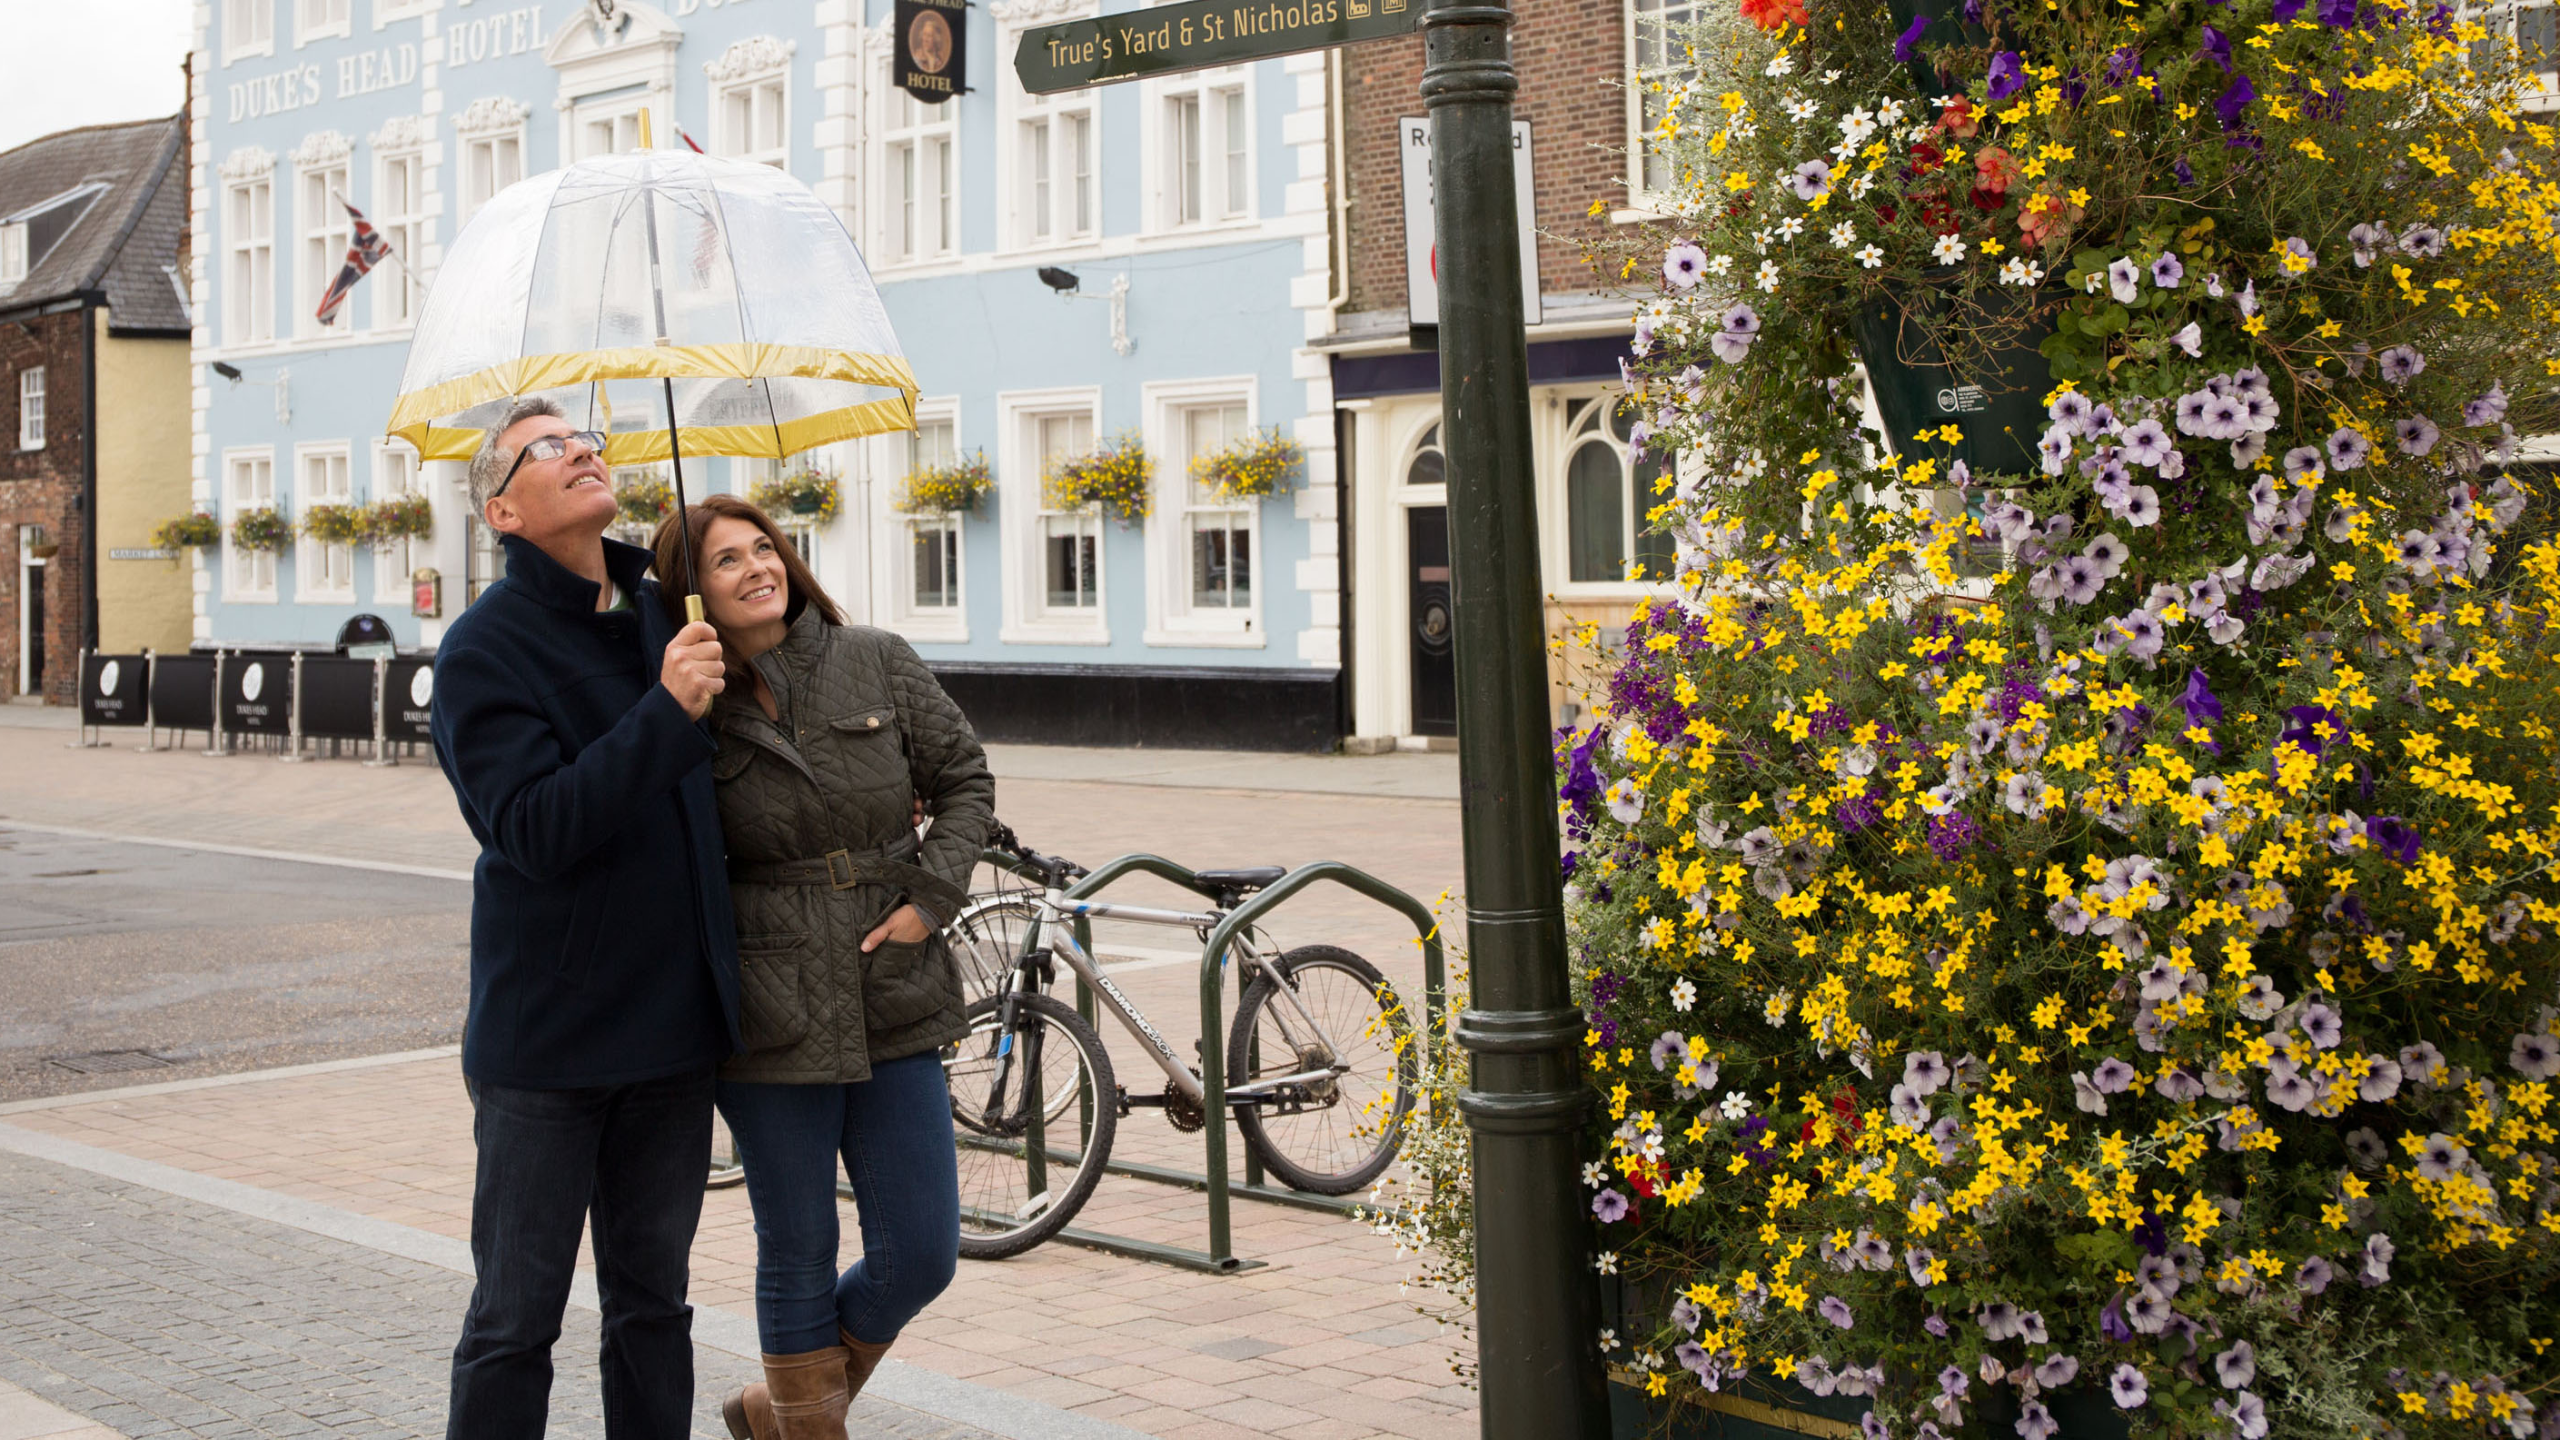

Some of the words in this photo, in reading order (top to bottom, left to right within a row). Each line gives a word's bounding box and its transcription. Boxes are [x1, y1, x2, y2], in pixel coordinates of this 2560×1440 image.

[228, 61, 321, 124] DUKE'S
[337, 43, 417, 99] HEAD
[447, 5, 549, 68] HOTEL
[1048, 32, 1112, 68] True's
[1120, 21, 1170, 57] Yard
[1180, 18, 1194, 47] &
[1202, 13, 1225, 44] St
[1234, 0, 1338, 38] Nicholas
[907, 72, 953, 92] HOTEL
[1099, 977, 1173, 1060] DIAMONDBACK
